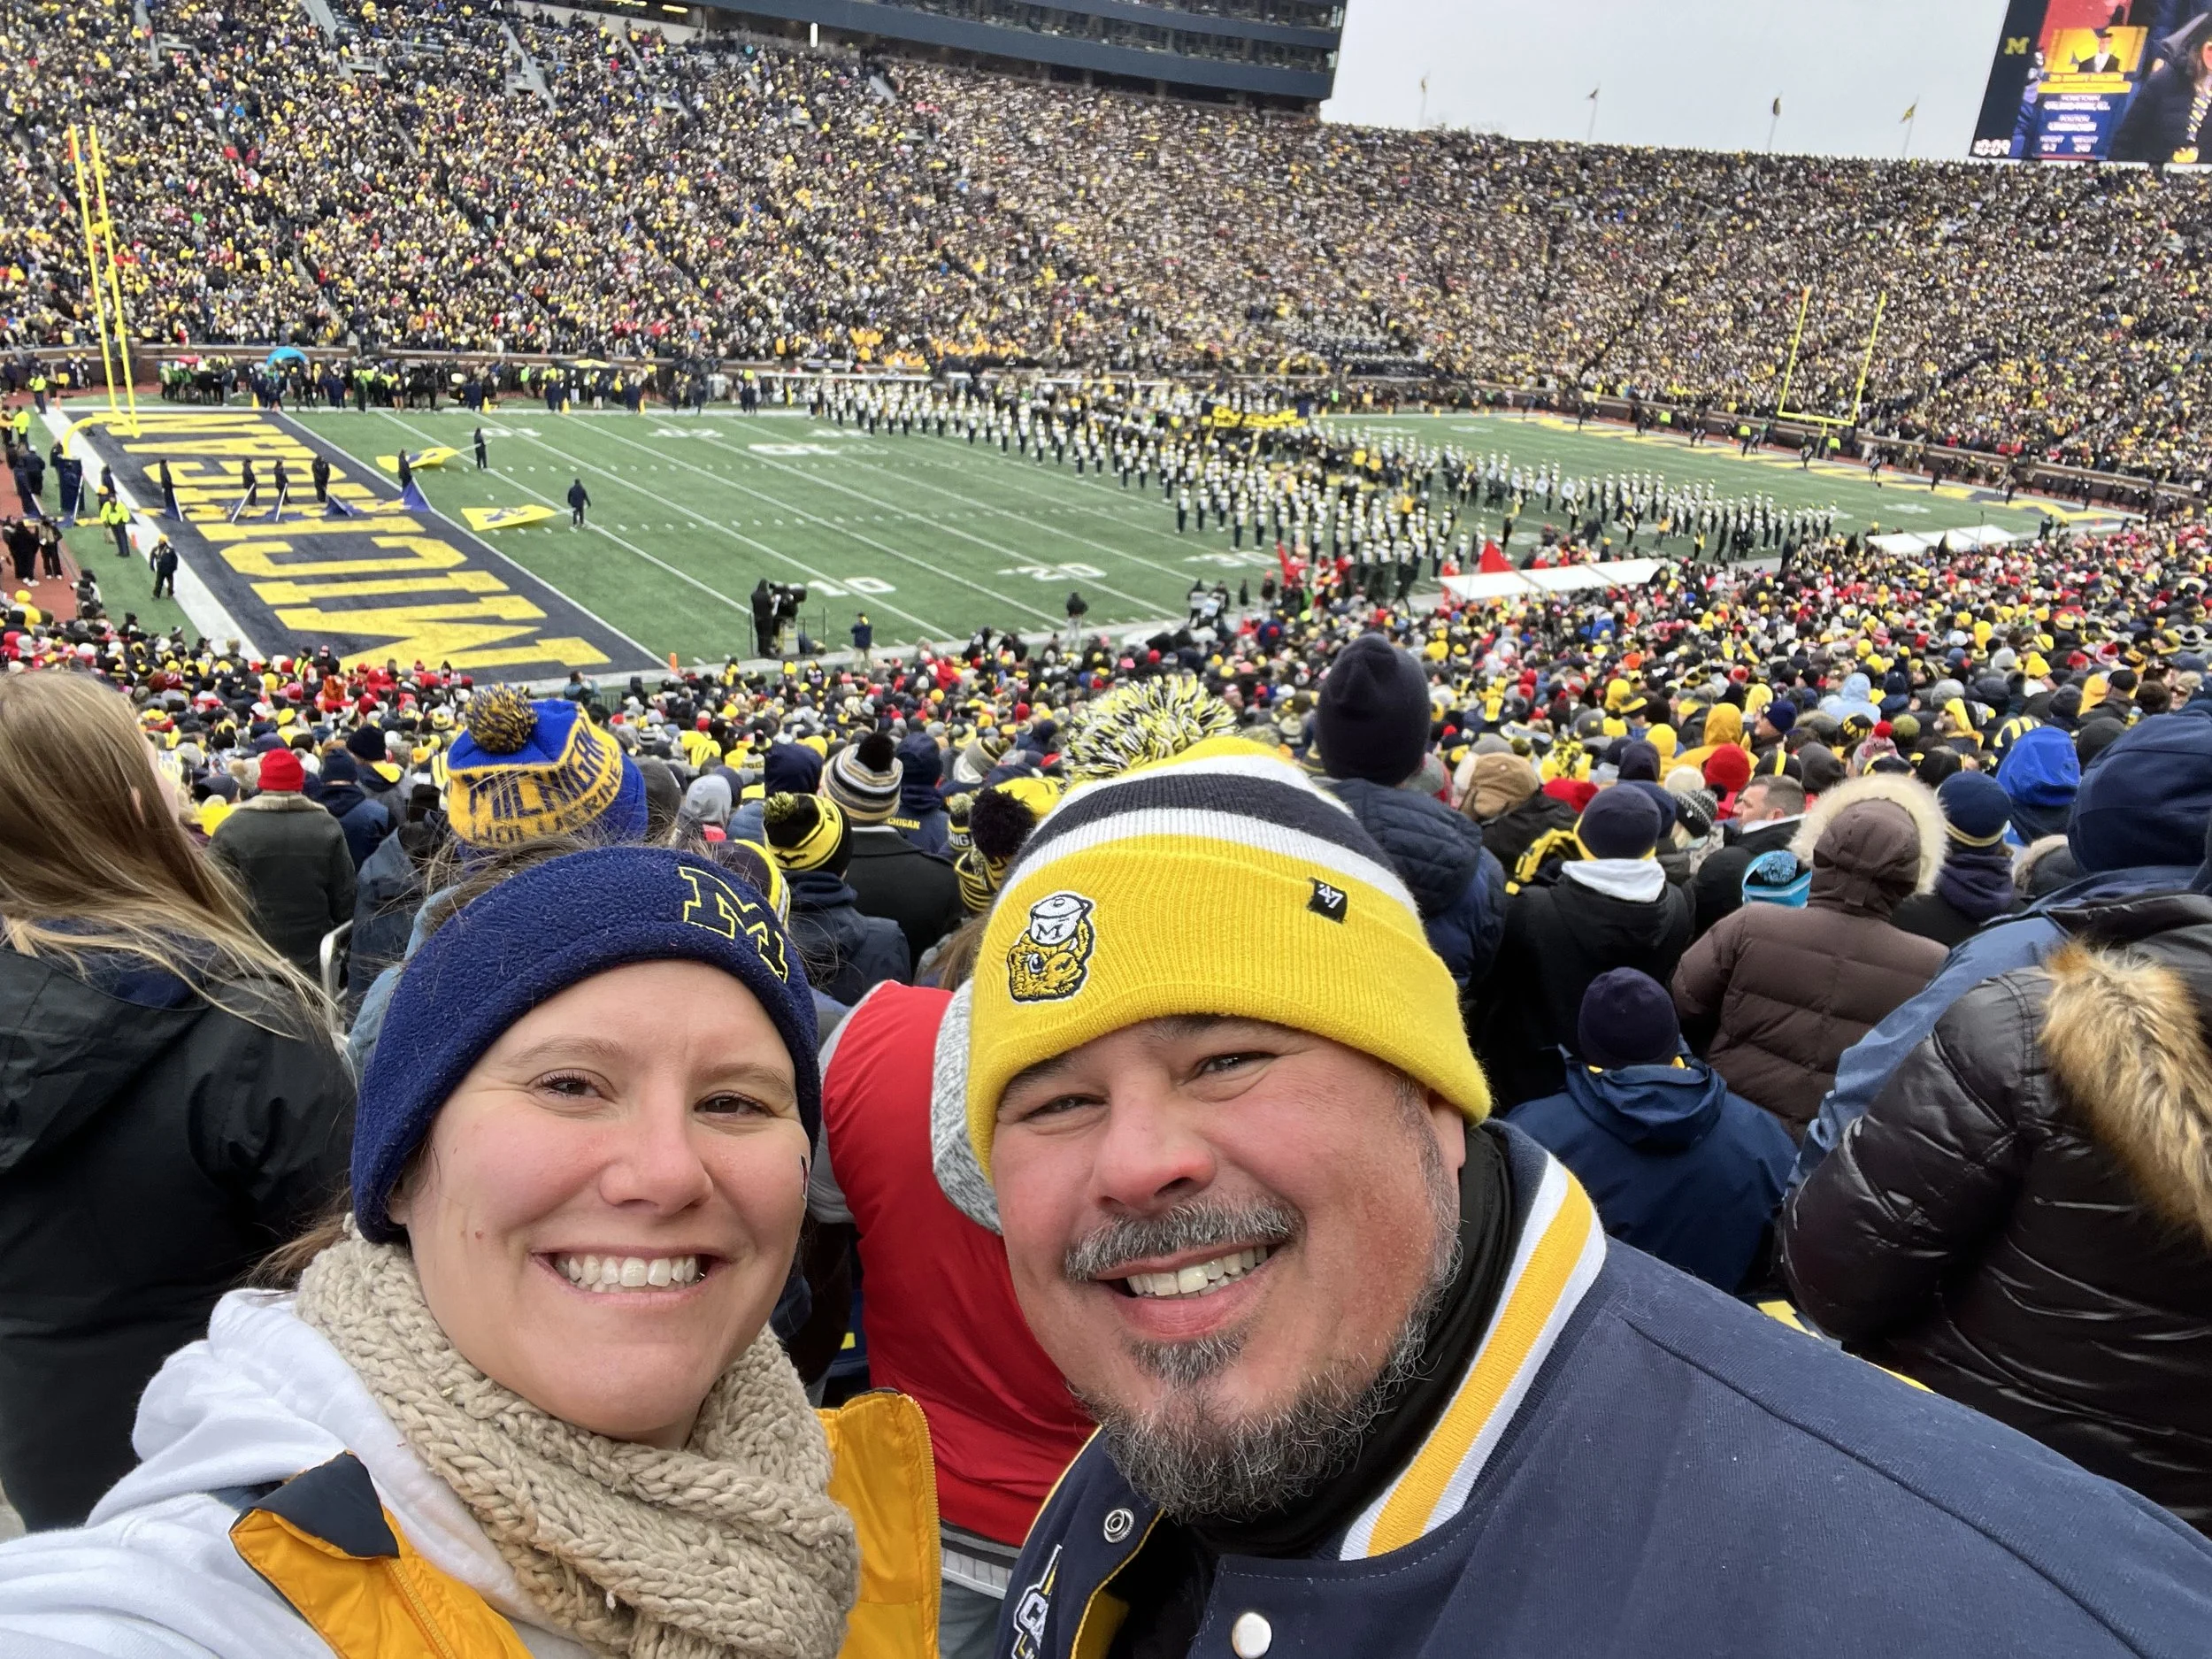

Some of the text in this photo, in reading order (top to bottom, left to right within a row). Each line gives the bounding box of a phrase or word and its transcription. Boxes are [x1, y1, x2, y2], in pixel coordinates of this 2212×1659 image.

[2004, 36, 2030, 55] M
[807, 577, 896, 596] 10
[461, 717, 605, 820] MICHIGAN
[887, 817, 920, 830] CHIGAN
[678, 866, 788, 984] M
[1036, 923, 1064, 940] M
